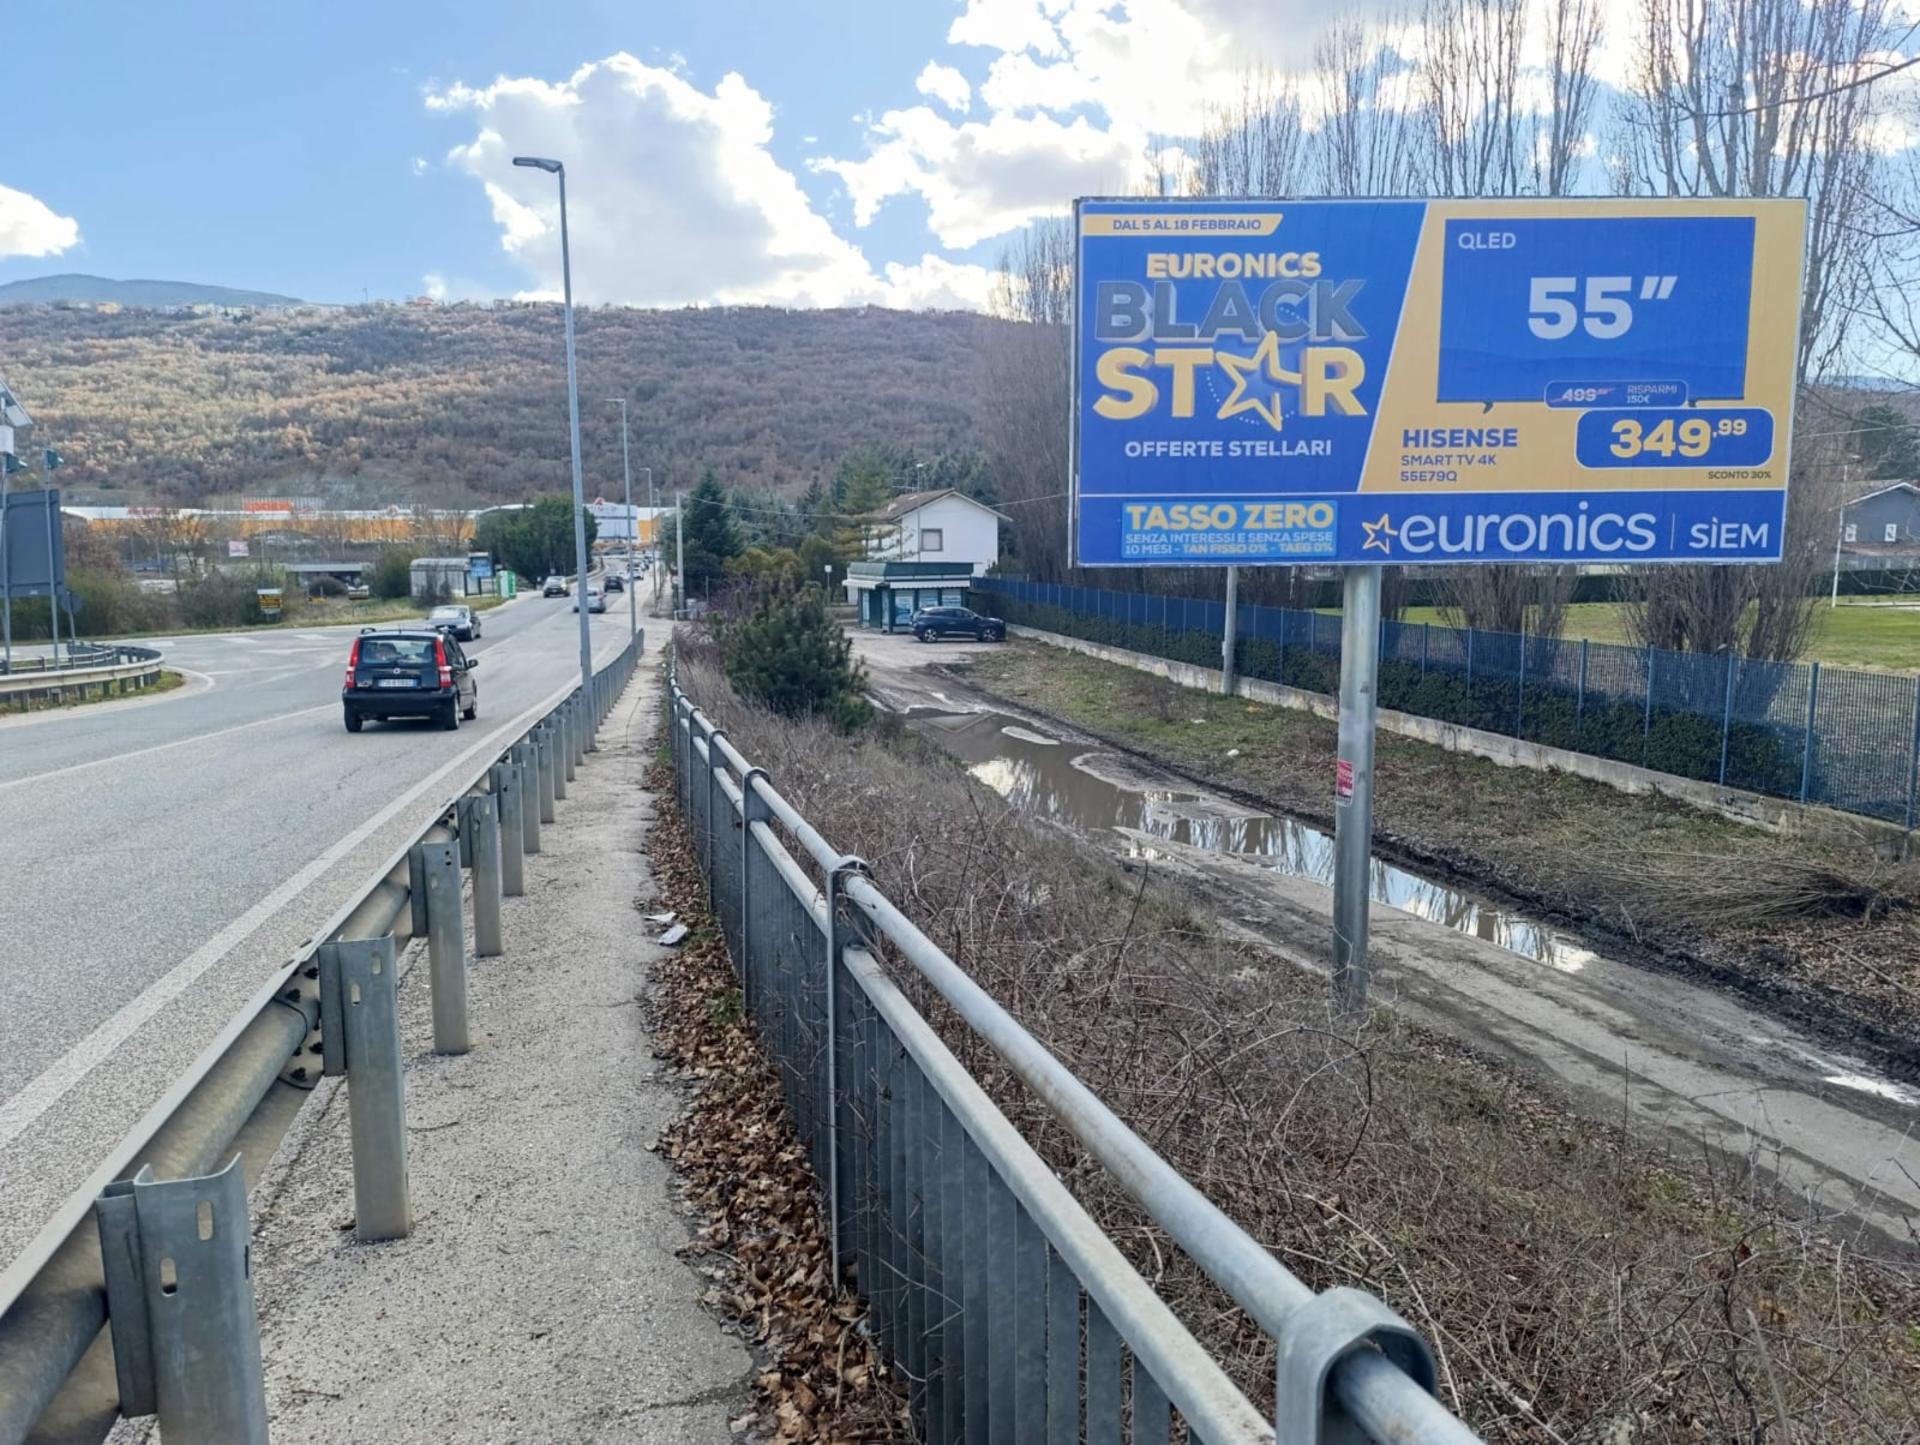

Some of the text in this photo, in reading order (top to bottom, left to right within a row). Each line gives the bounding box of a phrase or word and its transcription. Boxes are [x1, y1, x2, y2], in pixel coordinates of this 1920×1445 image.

[1113, 218, 1262, 231] DAL 5 AL 18 FEBBRAIO
[1457, 232, 1517, 250] QLED
[1146, 252, 1322, 279] EURONICS
[1095, 279, 1370, 343] BLACK
[1627, 384, 1678, 395] RISPARMI
[1402, 427, 1519, 449] HISENSE
[1124, 439, 1332, 458] OFFERTE STELLARI
[1401, 454, 1497, 466] SMART TV 4K
[1400, 470, 1458, 482] 55E79Q
[1708, 471, 1749, 480] SCONTO
[1125, 502, 1334, 531] TASSO ZERO
[1398, 501, 1657, 553] euronics
[1125, 531, 1334, 544] SENZA INTERESSI E SENZA SPESE
[1125, 544, 1140, 555] 10
[1142, 544, 1173, 555] MESI
[1182, 543, 1209, 554] TAN
[1210, 543, 1248, 554] FISSO
